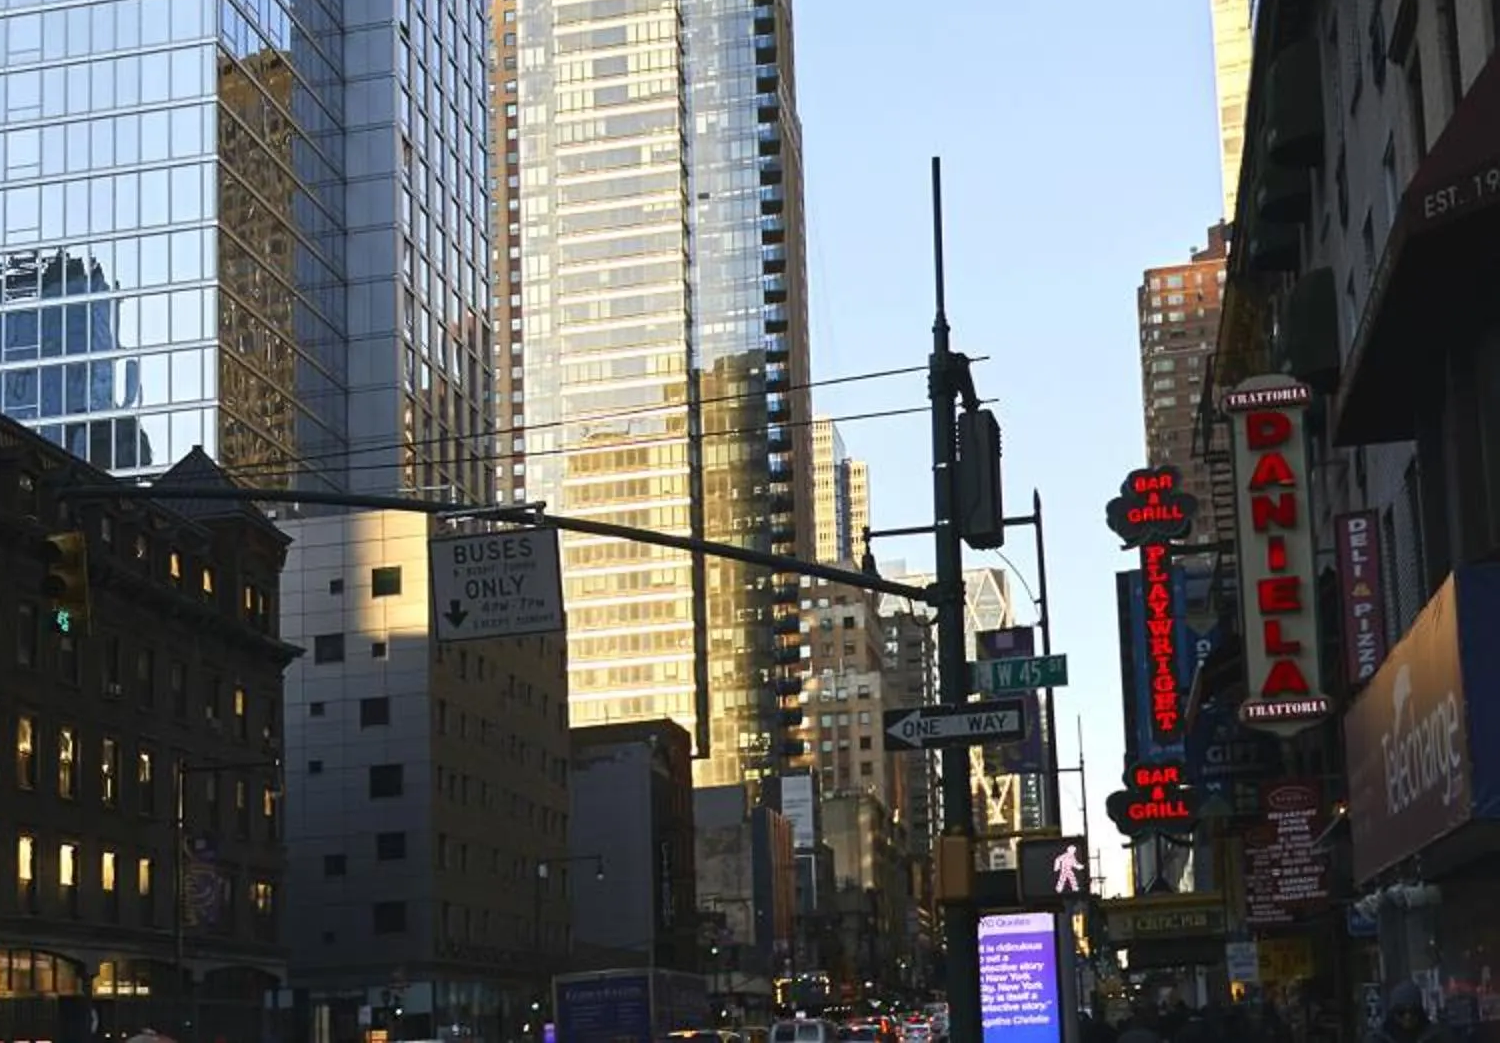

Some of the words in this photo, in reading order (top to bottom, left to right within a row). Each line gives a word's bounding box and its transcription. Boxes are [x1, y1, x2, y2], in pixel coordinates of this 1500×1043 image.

[1424, 185, 1466, 219] EST.
[1228, 385, 1308, 406] TRATTORIA
[1134, 473, 1174, 492] BAR
[1127, 505, 1185, 524] GRILL
[453, 537, 532, 564] BUSES
[1245, 411, 1309, 695] DANIELA
[1347, 518, 1369, 577] DELI
[465, 575, 524, 600] ONLY
[1145, 546, 1179, 732] PLAYWRIGHT
[997, 663, 1012, 686] W
[1019, 661, 1042, 684] 45
[1246, 699, 1329, 717] TRATTORIA
[902, 719, 941, 738] ONE
[967, 714, 1007, 732] WAY
[1382, 691, 1461, 814] Telecharge
[1135, 766, 1179, 786] BAR
[1127, 801, 1189, 820] GRILL
[996, 942, 1043, 952] ridiculous
[986, 974, 1008, 982] New
[1009, 973, 1031, 981] York
[1020, 962, 1044, 972] story
[997, 983, 1020, 992] New
[1021, 981, 1043, 990] York
